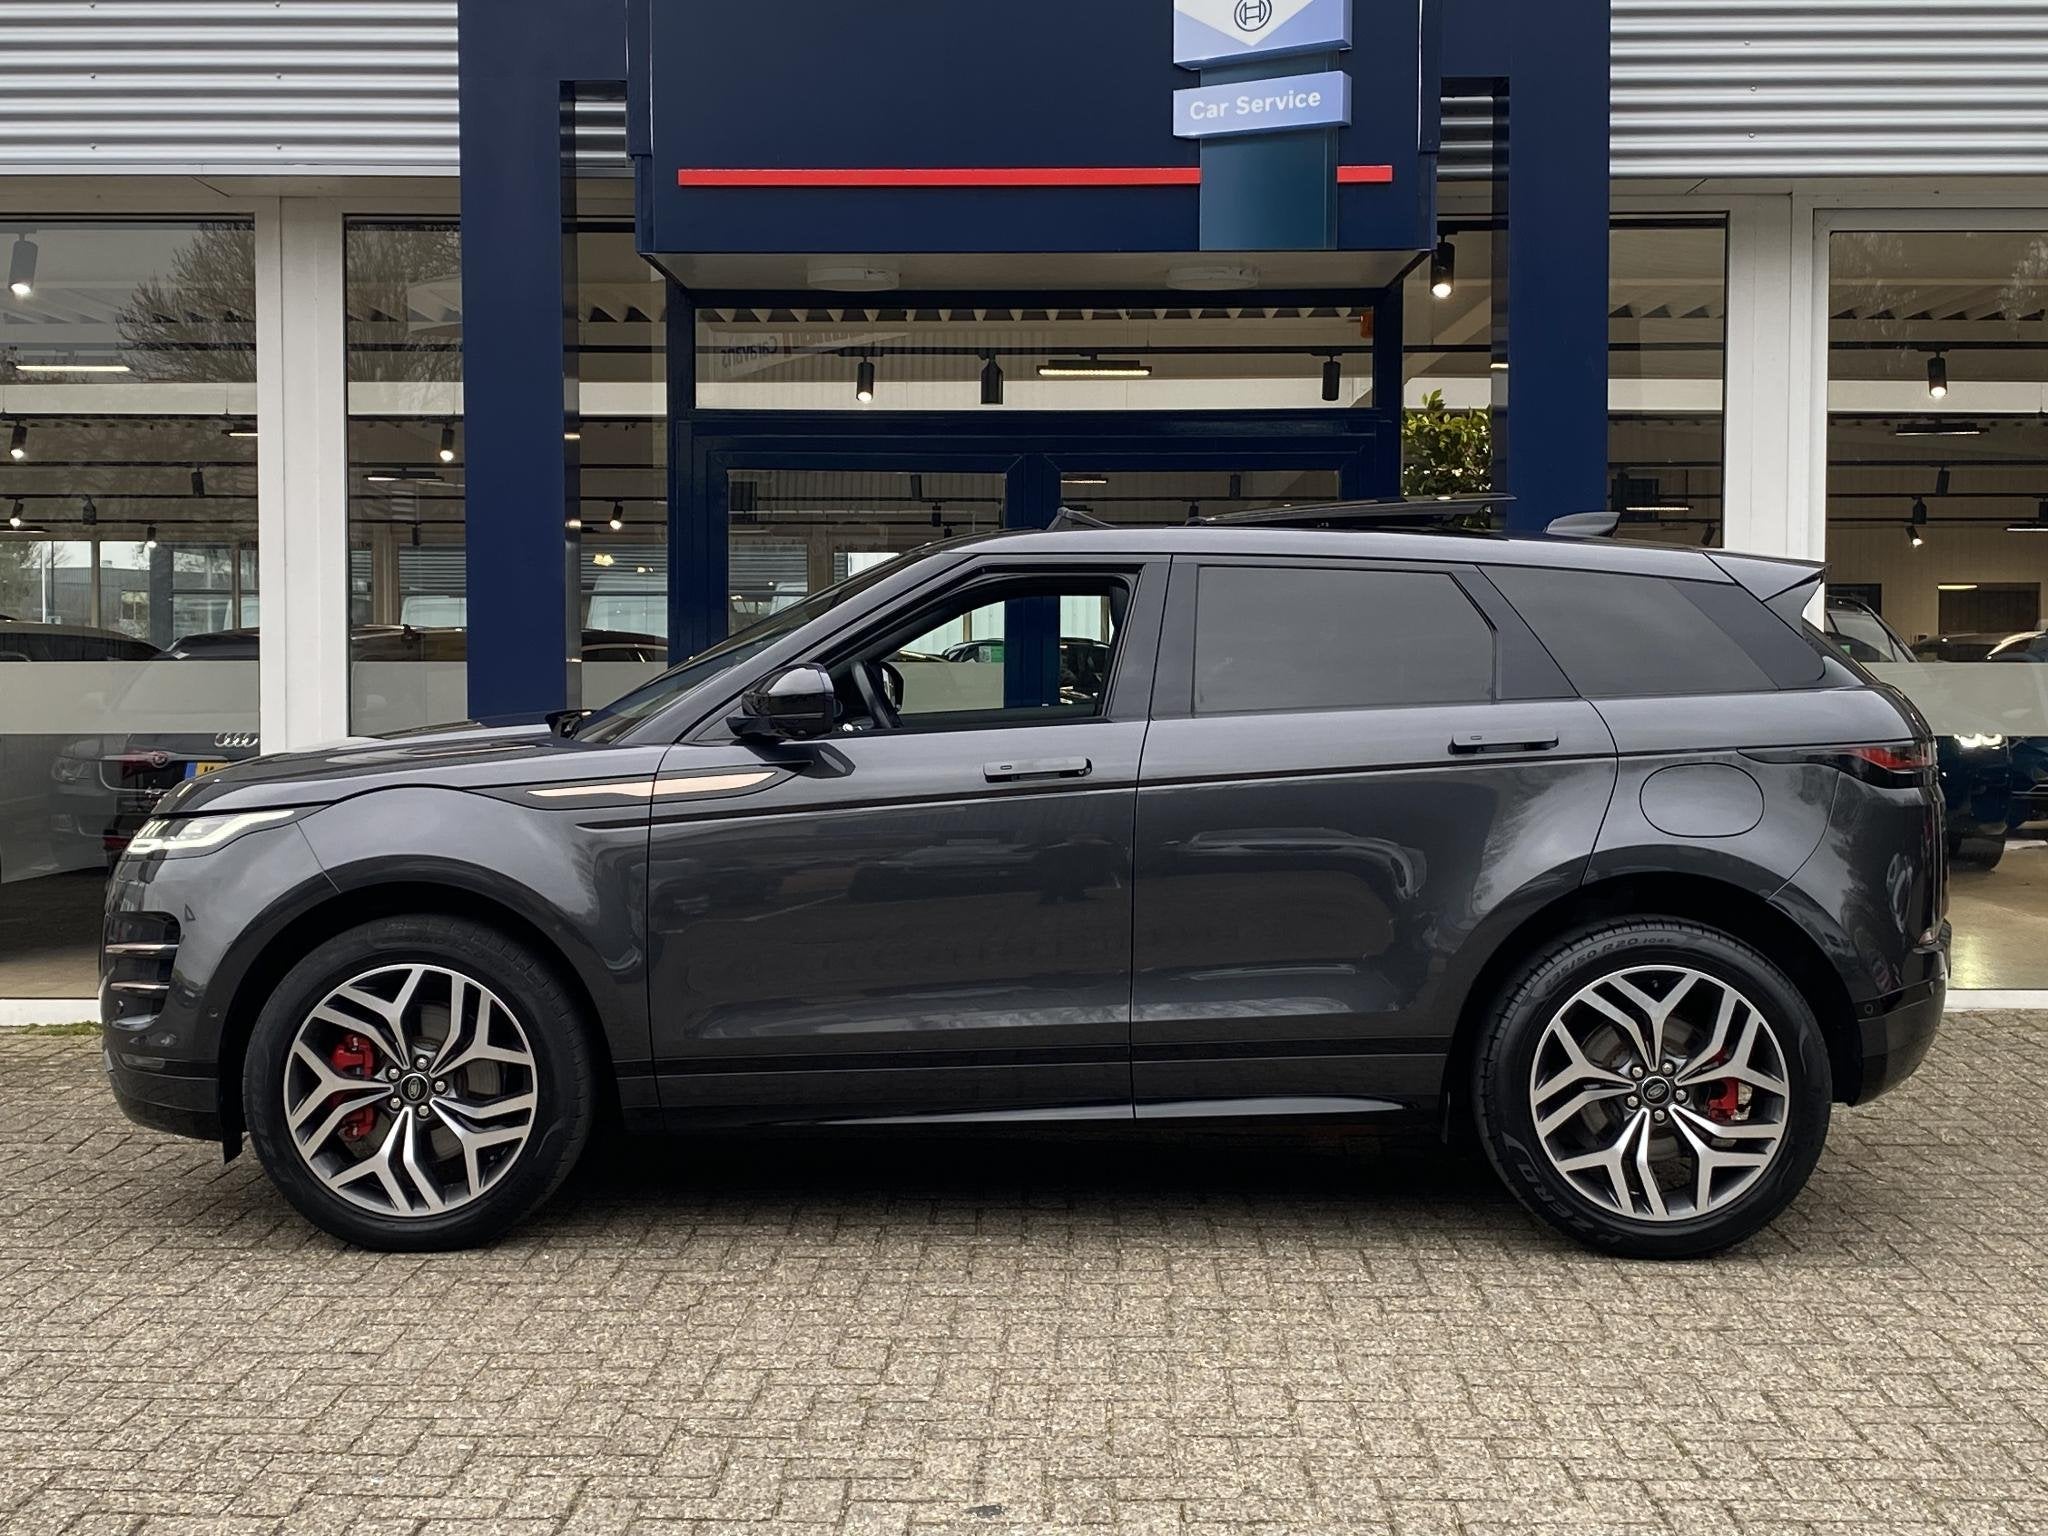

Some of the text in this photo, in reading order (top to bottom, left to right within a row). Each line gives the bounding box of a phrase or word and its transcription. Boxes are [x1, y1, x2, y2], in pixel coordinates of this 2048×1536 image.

[1190, 90, 1321, 120] Car Service
[1517, 1163, 1595, 1233] ZERO
